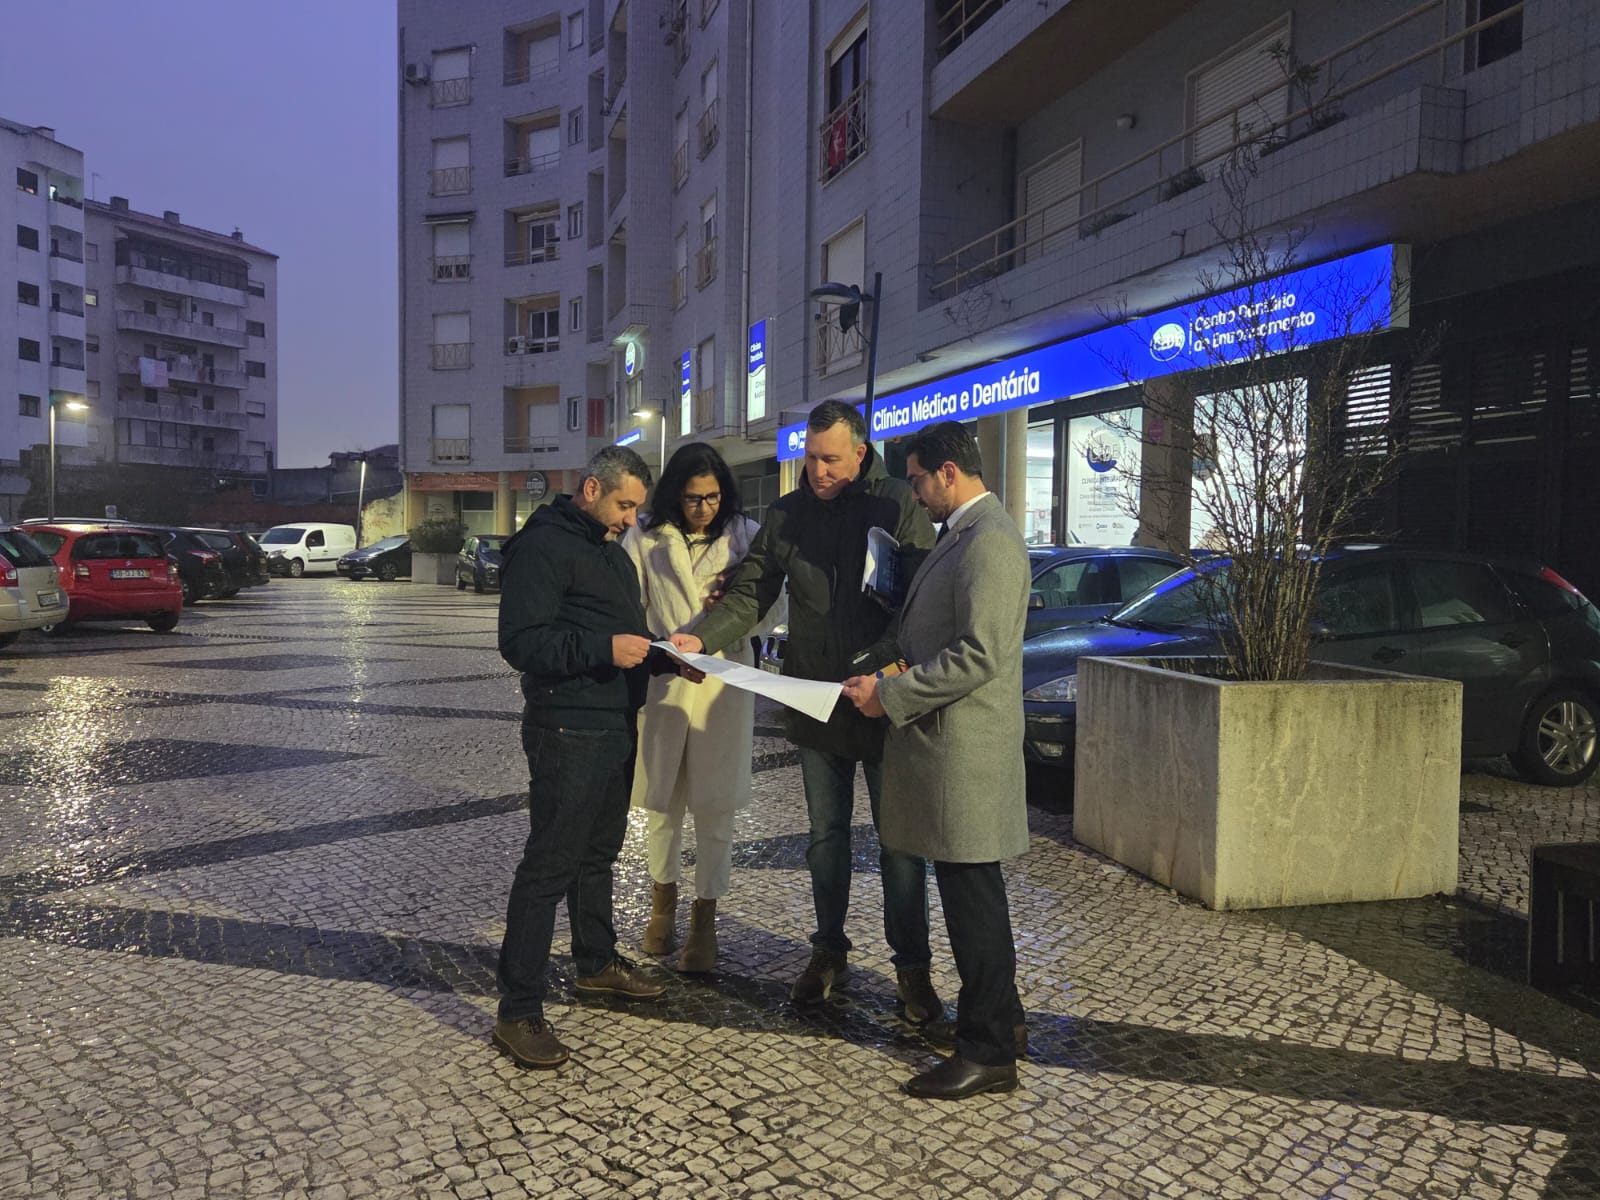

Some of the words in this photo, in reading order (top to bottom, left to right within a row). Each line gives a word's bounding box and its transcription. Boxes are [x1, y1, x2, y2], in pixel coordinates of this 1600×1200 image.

[1194, 309, 1236, 332] Centro
[1212, 311, 1316, 349] Entroamento
[873, 404, 910, 432] Clínica
[911, 391, 957, 424] Médica
[960, 390, 970, 411] e
[972, 366, 1040, 408] Dentária
